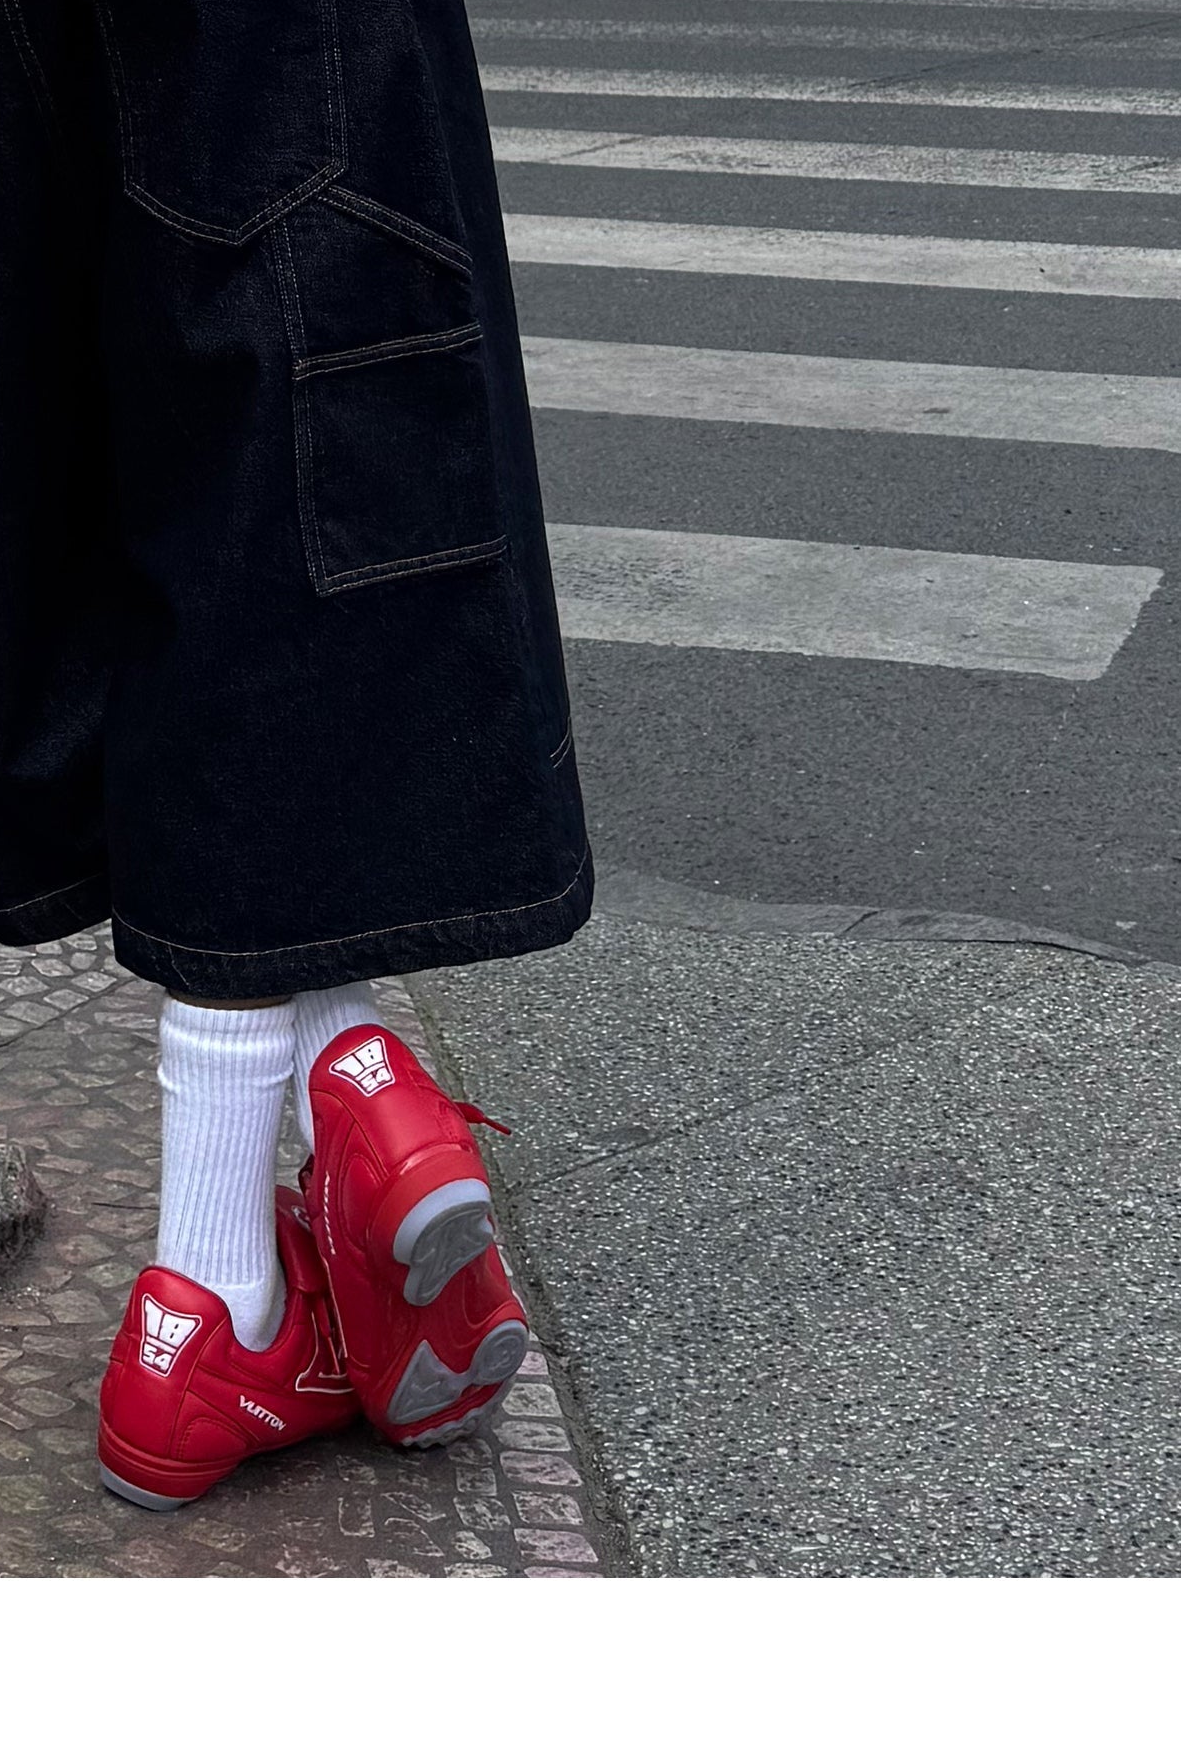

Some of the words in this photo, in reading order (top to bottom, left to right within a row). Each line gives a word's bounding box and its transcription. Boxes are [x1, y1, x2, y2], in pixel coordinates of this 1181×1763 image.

[333, 1040, 384, 1077] 18
[145, 1299, 196, 1348] 18
[142, 1343, 173, 1371] 54
[239, 1395, 287, 1431] VUITTON
